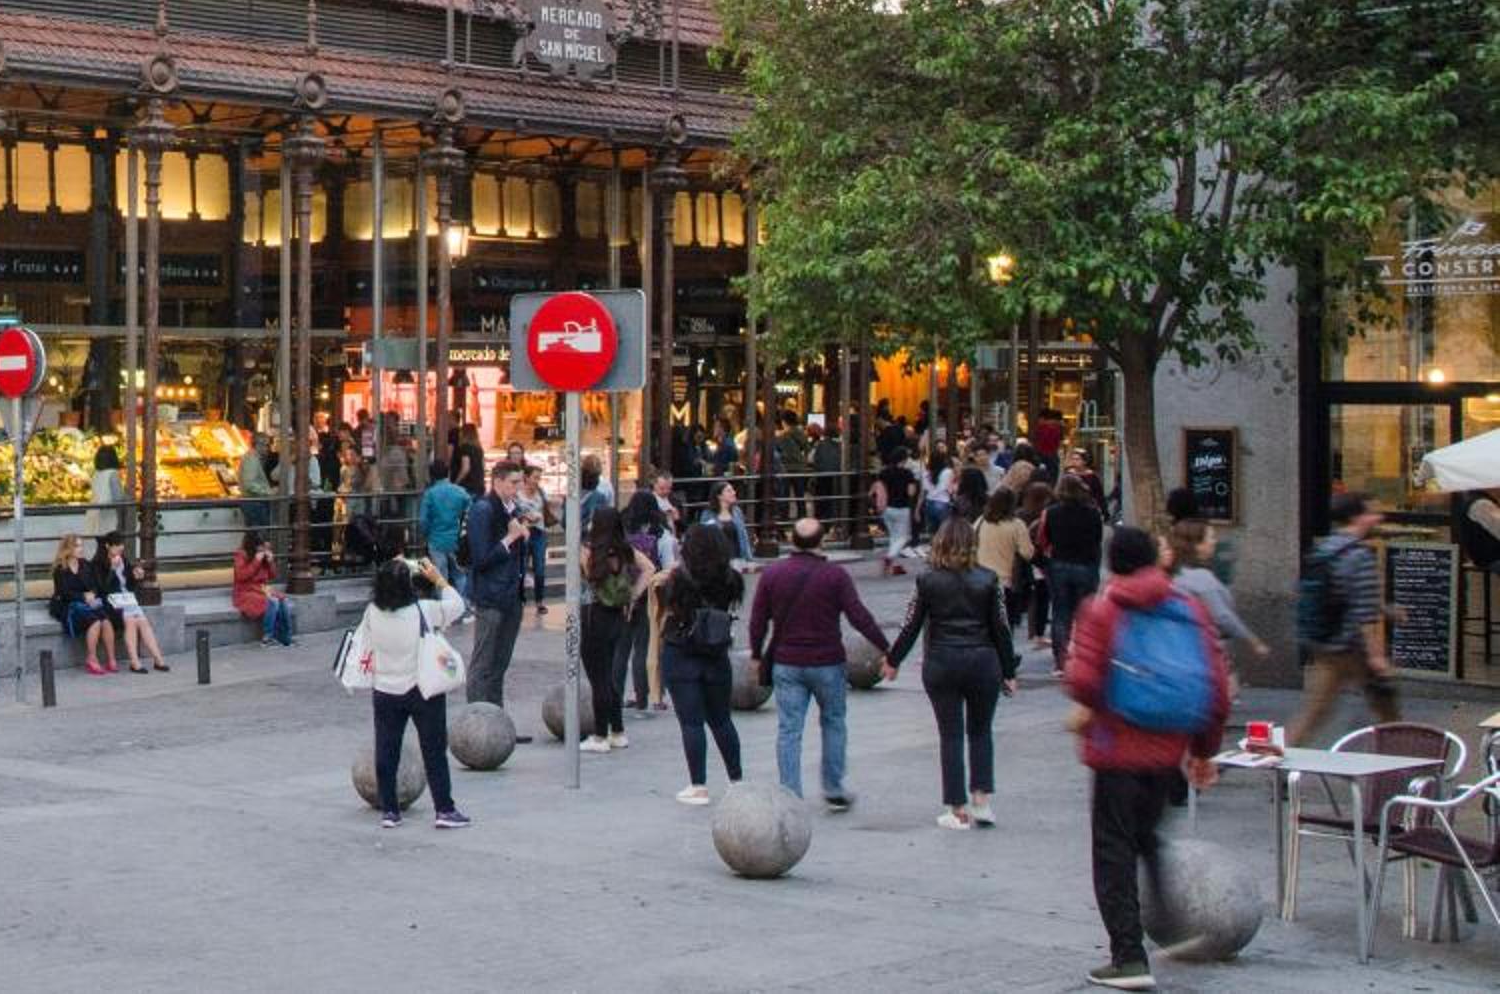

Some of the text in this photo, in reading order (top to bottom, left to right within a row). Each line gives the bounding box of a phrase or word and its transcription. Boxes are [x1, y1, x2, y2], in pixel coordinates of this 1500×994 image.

[541, 6, 602, 30] MERCADO
[563, 27, 581, 40] DE
[539, 39, 605, 62] SAN MIGUEL
[1403, 259, 1500, 277] CONSER
[481, 316, 508, 335] MA
[450, 345, 496, 361] mercado
